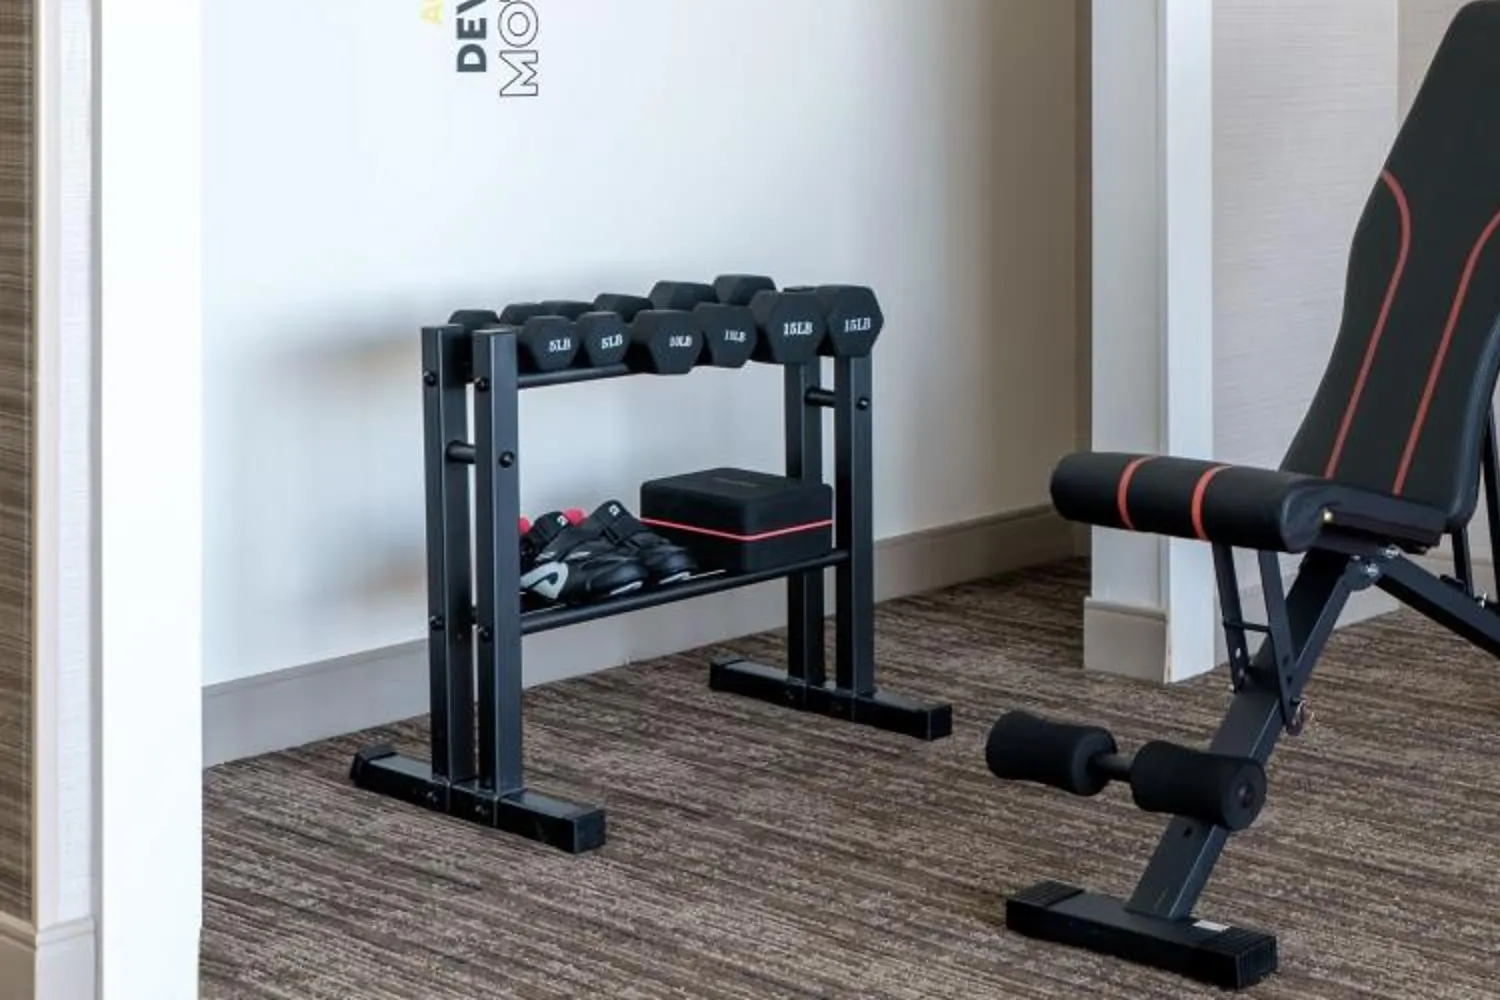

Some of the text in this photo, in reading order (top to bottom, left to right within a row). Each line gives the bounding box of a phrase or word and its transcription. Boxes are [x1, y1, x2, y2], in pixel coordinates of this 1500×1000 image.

[784, 321, 814, 336] 15LB
[844, 318, 871, 332] 15LB
[601, 333, 623, 349] 5LB
